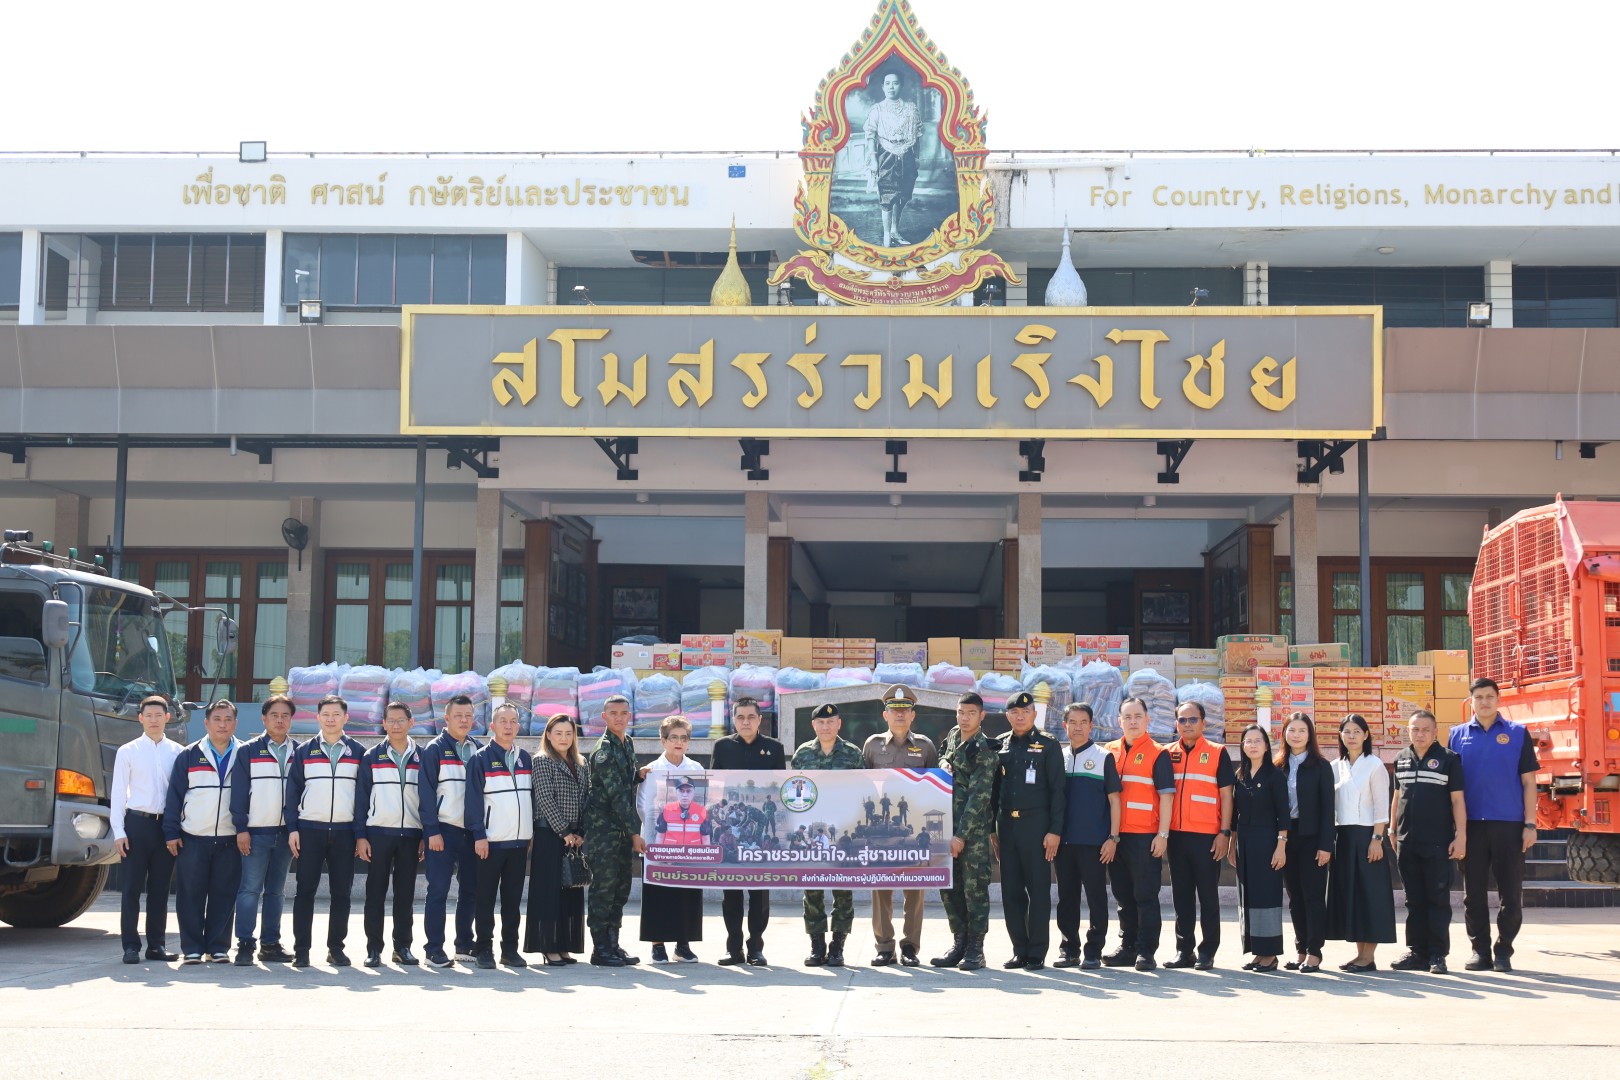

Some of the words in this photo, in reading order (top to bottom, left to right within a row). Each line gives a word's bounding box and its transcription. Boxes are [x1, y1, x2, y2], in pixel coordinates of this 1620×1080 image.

[181, 166, 287, 206] เพื่อชาติ
[310, 172, 388, 206] ศาสน์
[408, 174, 690, 208] กษัตริย์และประชาชน
[1090, 185, 1131, 206] For
[1153, 185, 1266, 210] Country,
[1280, 184, 1409, 210] Religions,
[1424, 182, 1557, 210] Monarchy
[1563, 183, 1612, 205] and
[491, 322, 1297, 411] สโมสรร่วมเริงไชย
[737, 841, 931, 867] โคราชรวมน้ำใจ...สู่ชายแดน
[651, 869, 798, 882] ศูนย์รวมสิ่งของบริจาค
